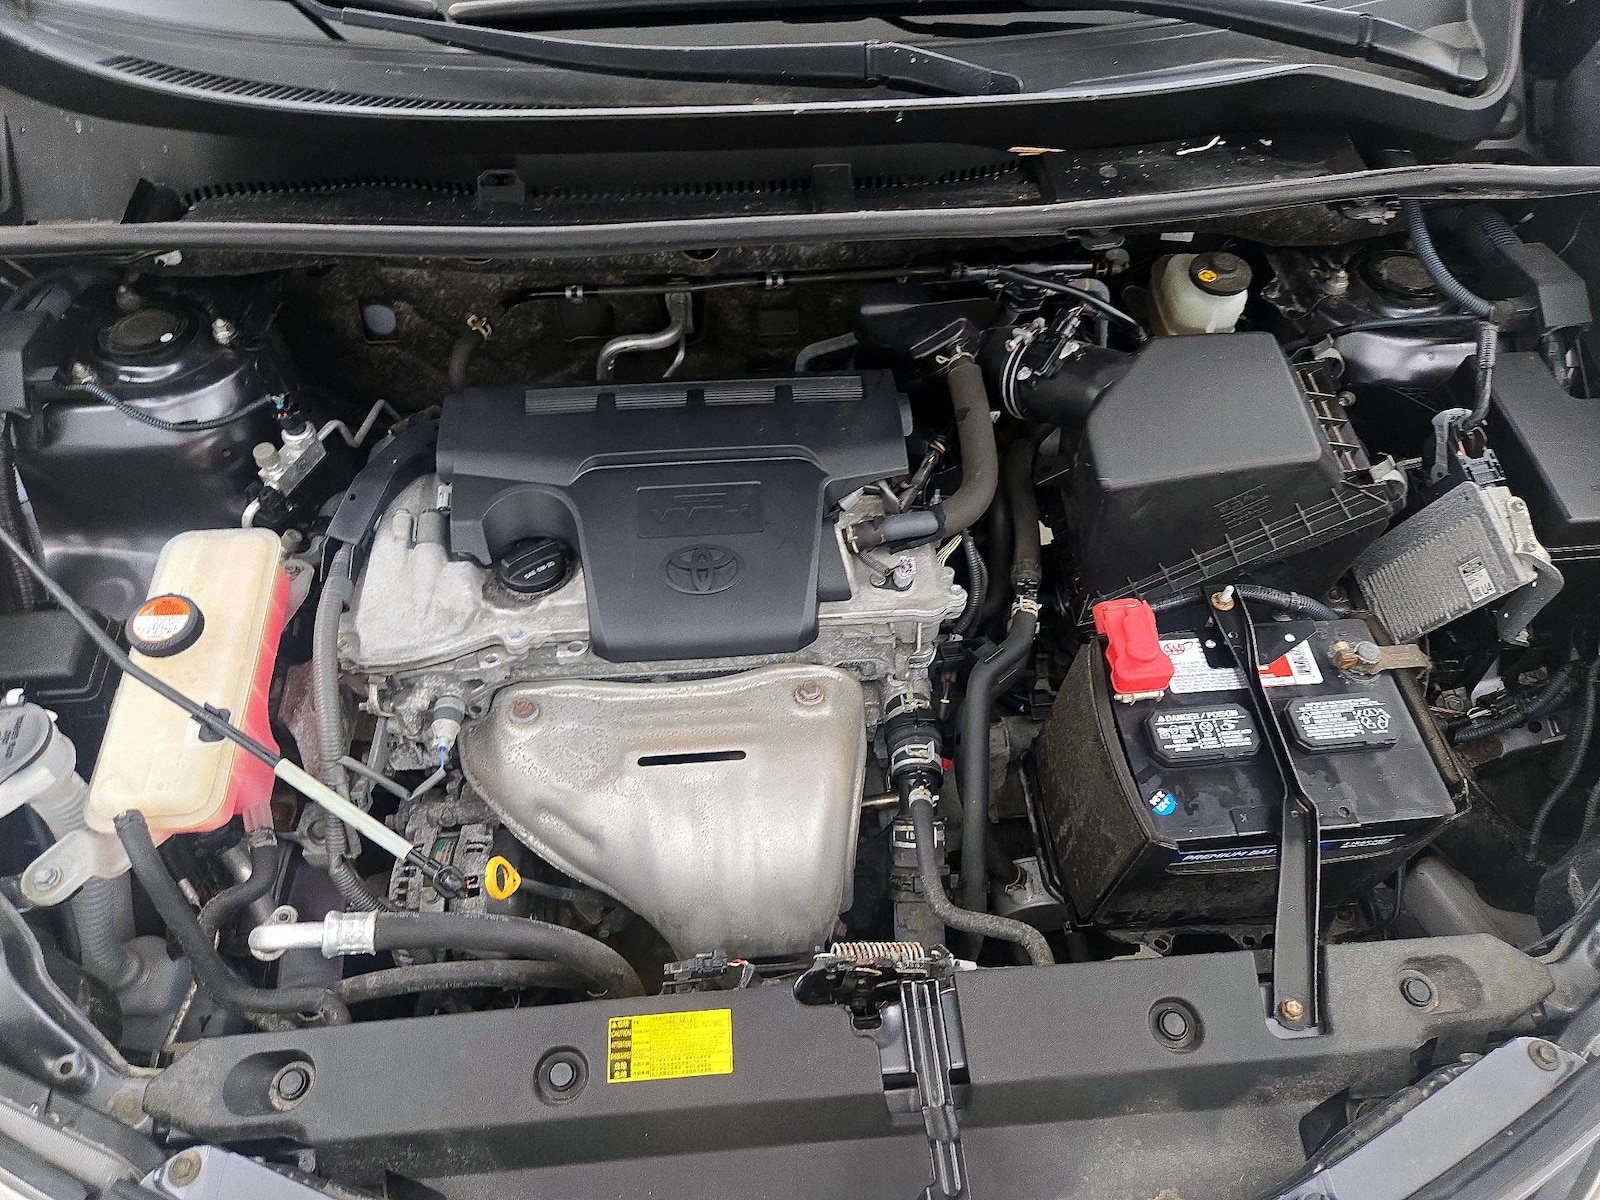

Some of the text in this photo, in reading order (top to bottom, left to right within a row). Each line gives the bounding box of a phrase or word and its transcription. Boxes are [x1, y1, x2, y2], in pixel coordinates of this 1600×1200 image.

[1164, 712, 1200, 722] DANGER
[1182, 848, 1277, 861] PREMIUM BAT
